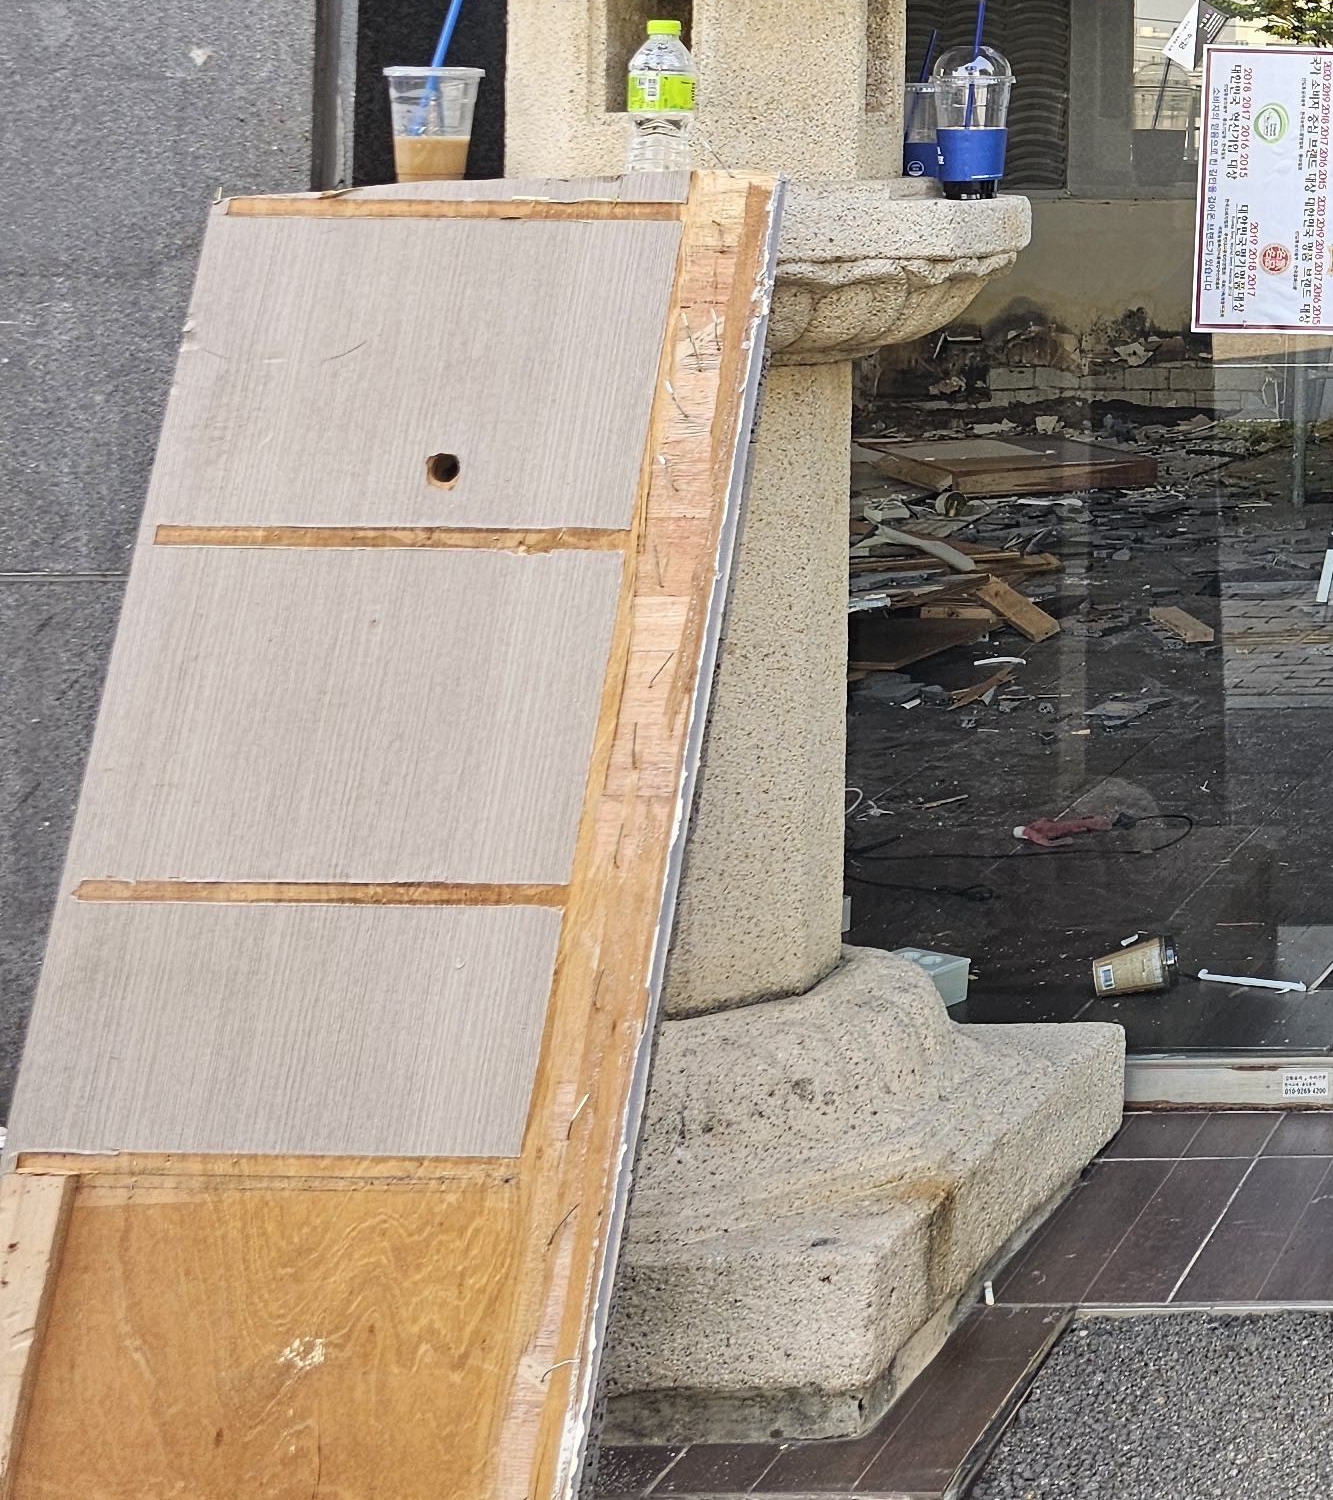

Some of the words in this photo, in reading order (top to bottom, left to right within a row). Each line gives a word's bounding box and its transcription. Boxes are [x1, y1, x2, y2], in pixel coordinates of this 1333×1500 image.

[1310, 56, 1322, 75] 국가
[1323, 61, 1332, 81] 2020
[1230, 65, 1241, 105] 대한민국
[1243, 68, 1252, 92] 2018
[1309, 79, 1321, 110] 소비자
[1322, 83, 1331, 102] 2019
[1212, 88, 1220, 120] 소비자의
[1242, 97, 1251, 120] 2017
[1321, 104, 1330, 124] 2018
[1228, 112, 1240, 153] 혁신기업
[1307, 114, 1319, 134] 중심
[1241, 125, 1250, 149] 2016
[1320, 126, 1329, 145] 2017
[1209, 158, 1218, 166] 한
[1306, 138, 1319, 169] 브랜드
[1319, 148, 1328, 167] 2016
[1226, 160, 1238, 180] 대상
[1239, 154, 1248, 178] 2015
[1305, 174, 1318, 193] 대상
[1318, 170, 1327, 189] 2015
[1207, 196, 1216, 220] 걸어온
[1317, 196, 1326, 216] 2020
[1303, 198, 1315, 238] 대한민국
[1316, 218, 1325, 238] 2019
[1205, 223, 1214, 255] 브랜드가
[1250, 222, 1258, 245] 2019
[1248, 248, 1257, 271] 2018
[1315, 240, 1324, 259] 2018
[1204, 259, 1212, 291] 있습니다
[1314, 262, 1323, 281] 2017
[1247, 274, 1256, 297] 2017
[1301, 267, 1312, 298] 브랜드
[1313, 283, 1322, 303] 2016
[1299, 304, 1311, 324] 대상
[1312, 305, 1321, 325] 2015
